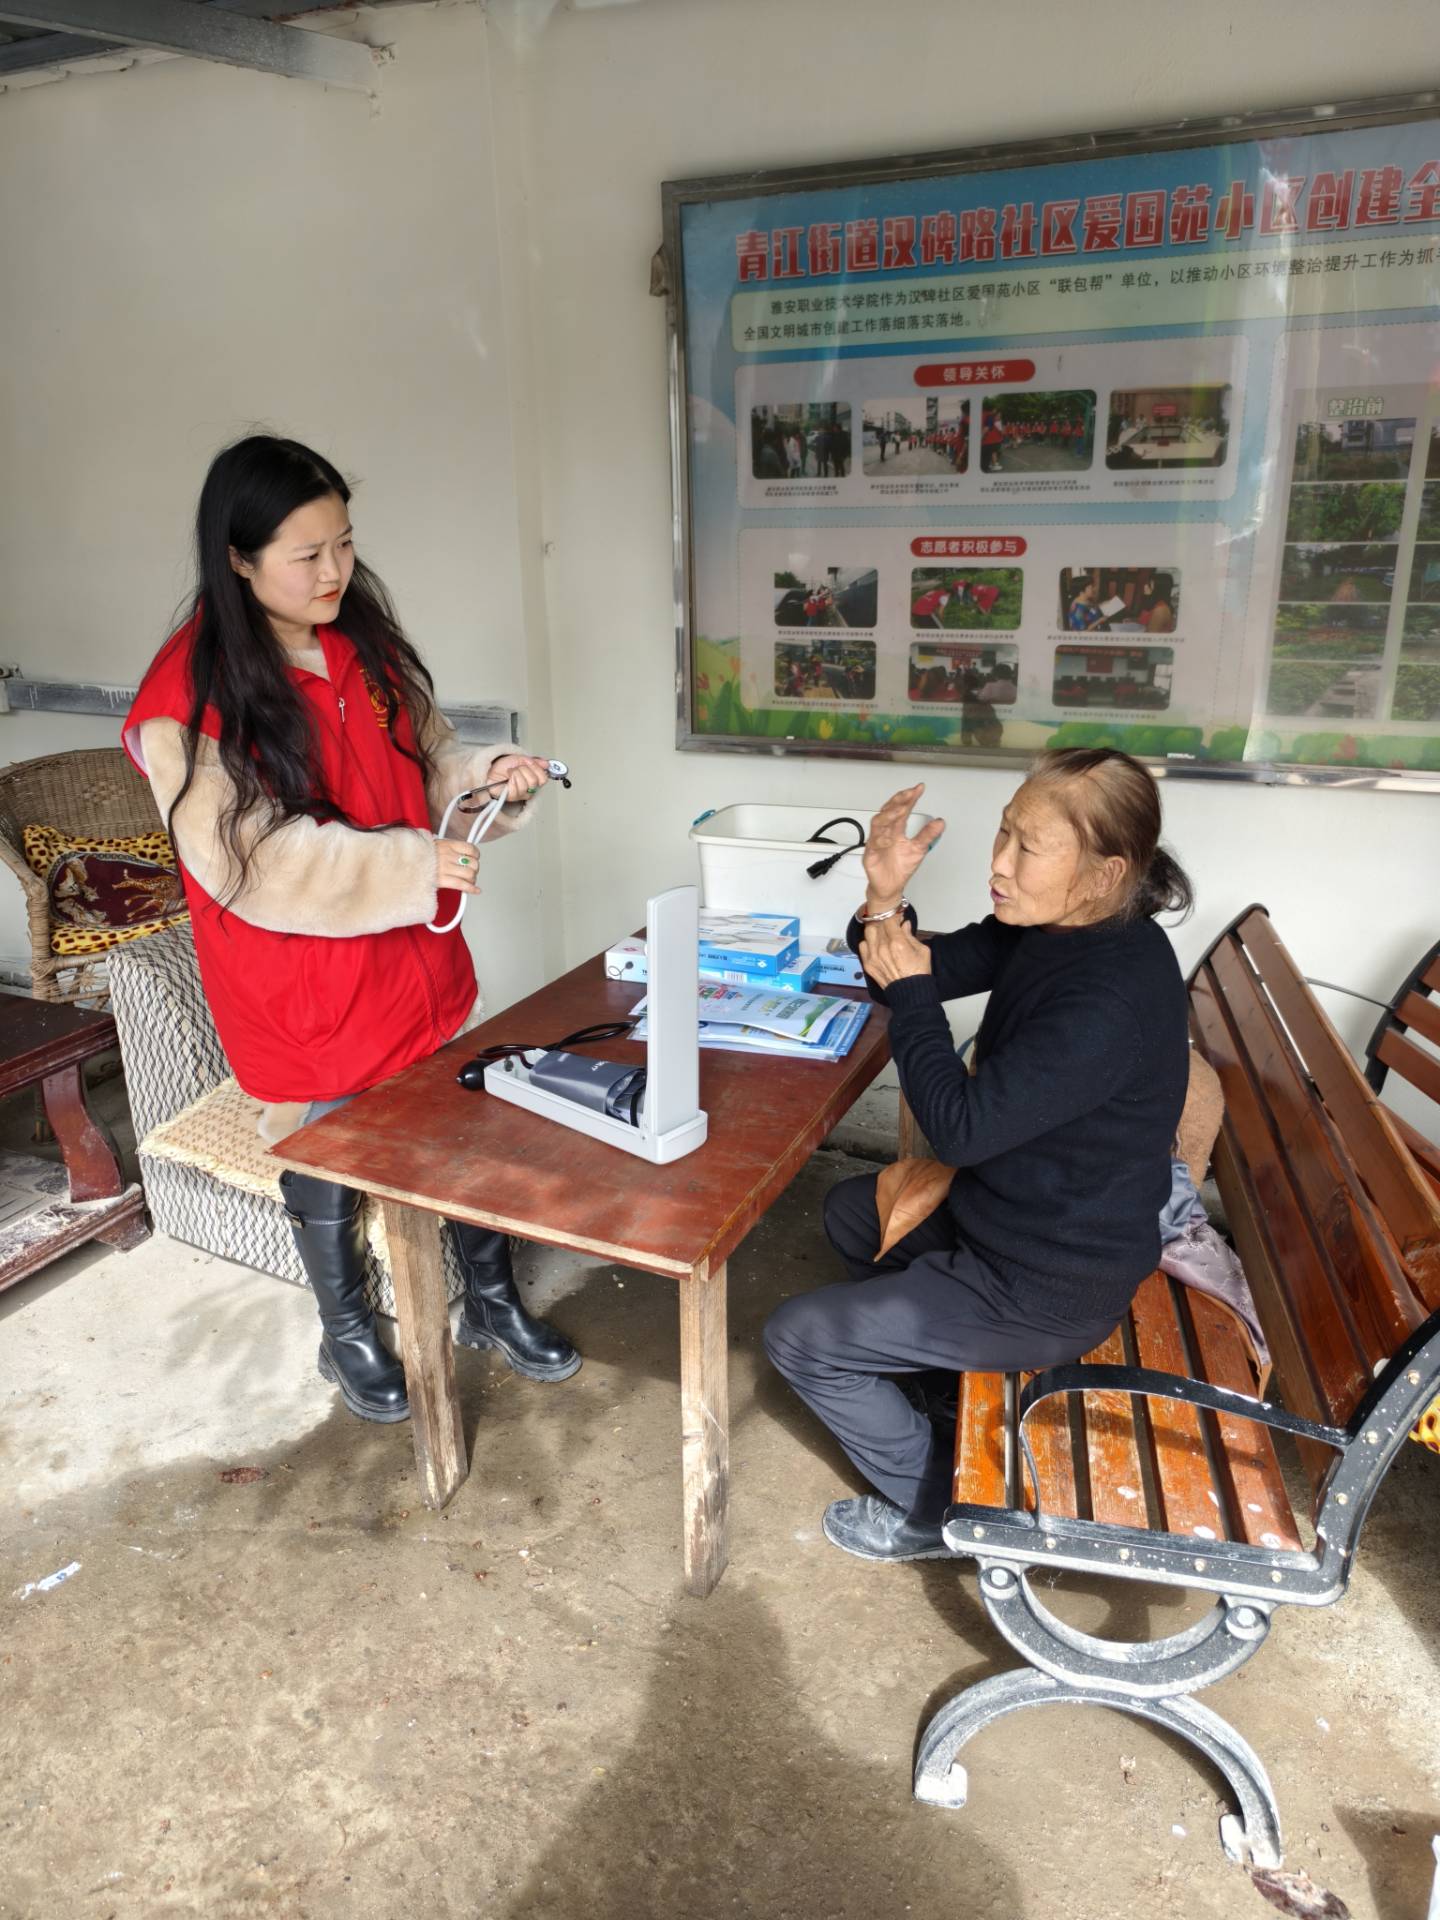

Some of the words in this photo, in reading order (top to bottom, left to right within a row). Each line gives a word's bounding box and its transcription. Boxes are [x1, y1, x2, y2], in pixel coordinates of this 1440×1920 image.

[943, 365, 1006, 383] 领导关怀
[1326, 396, 1384, 417] 整治前
[920, 540, 1018, 554] 志愿者积极参与
